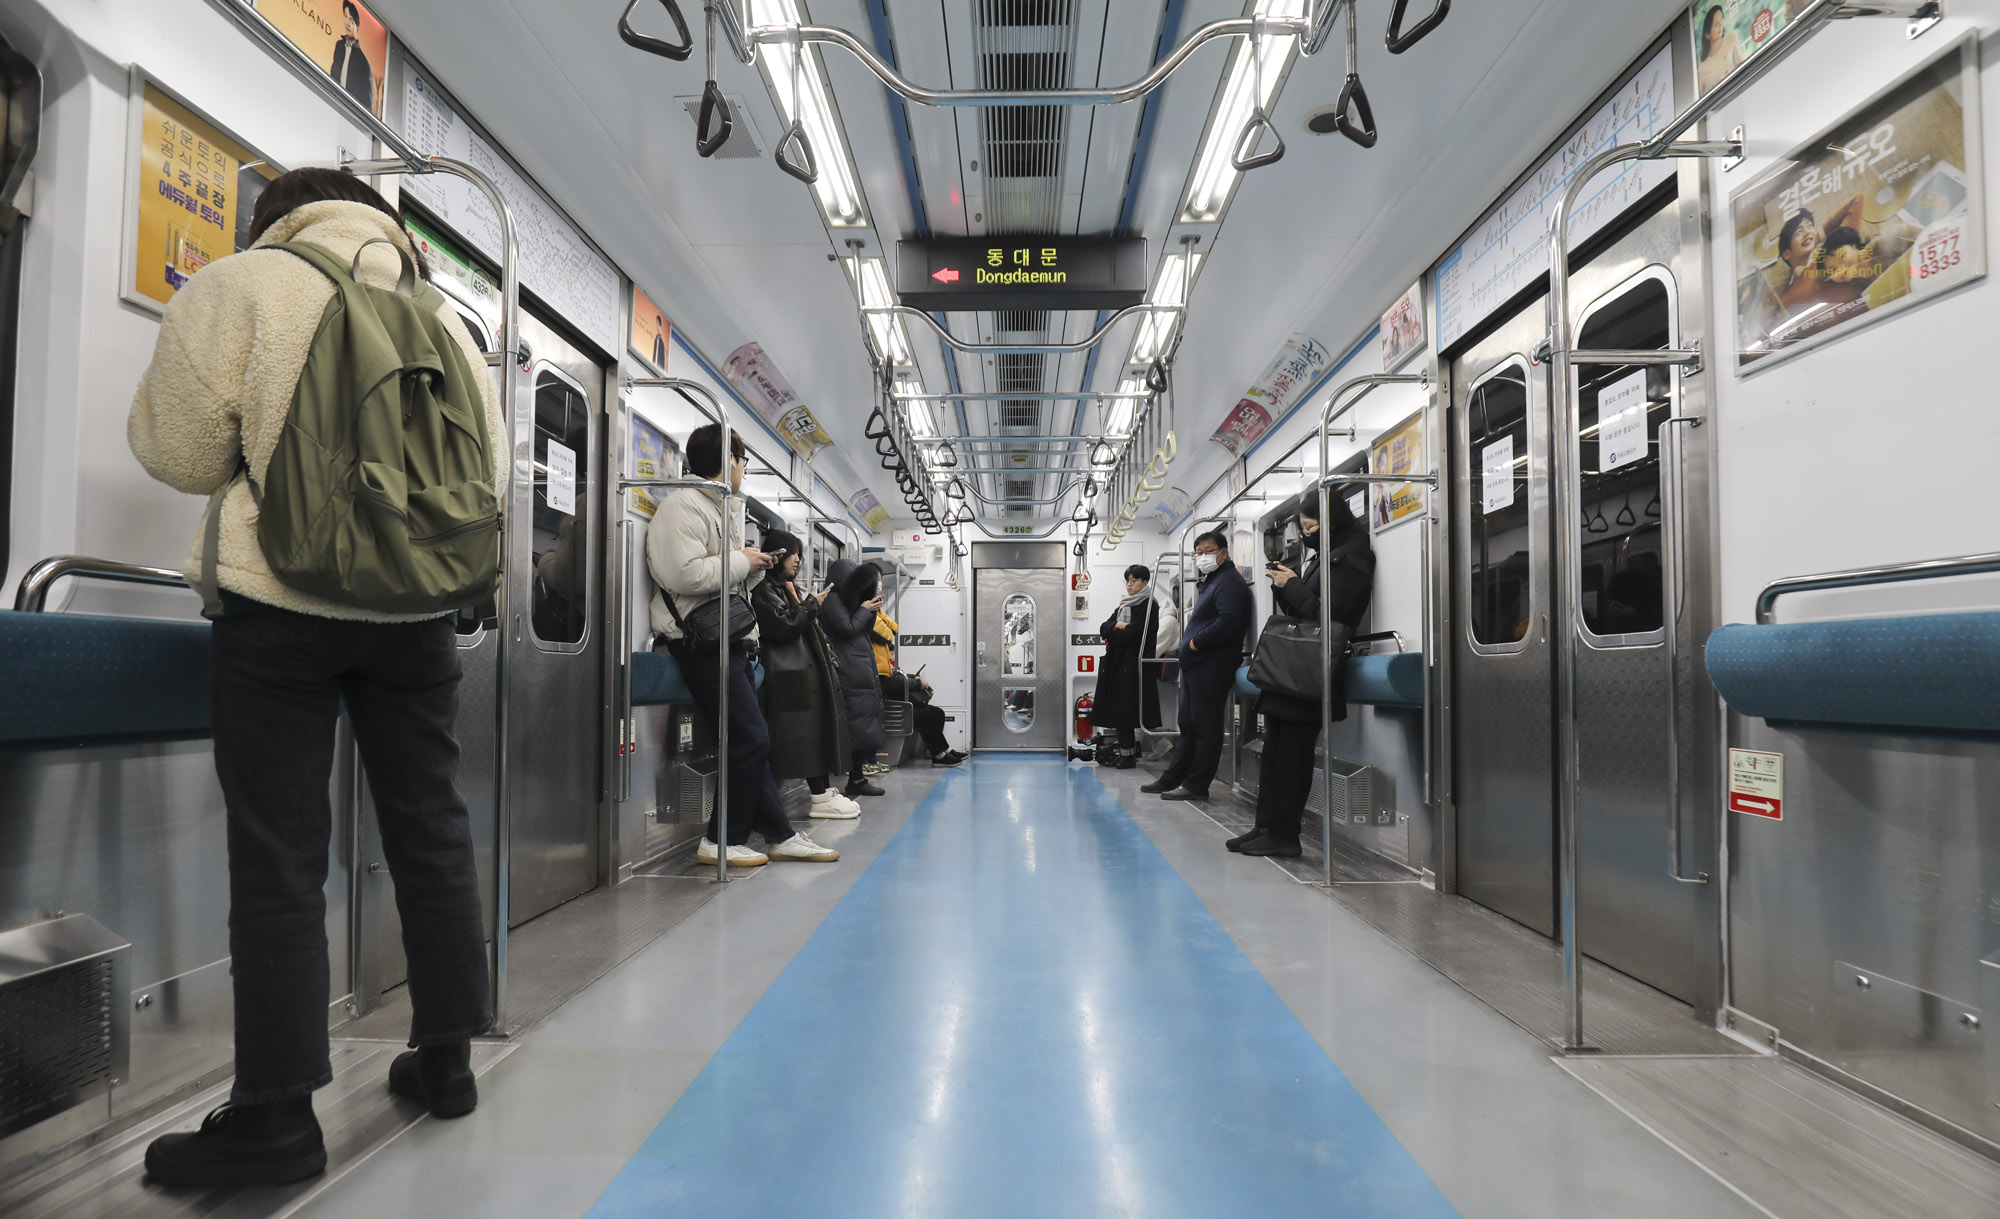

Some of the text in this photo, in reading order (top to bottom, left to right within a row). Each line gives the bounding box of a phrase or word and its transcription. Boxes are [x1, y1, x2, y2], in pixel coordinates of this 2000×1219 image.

[161, 137, 225, 191] 공식으로
[159, 179, 225, 231] 에듀윌 토익
[1919, 234, 1959, 264] 1577
[184, 257, 199, 273] LC
[976, 268, 1067, 284] Dongdaemun
[1920, 250, 1961, 279] 8333
